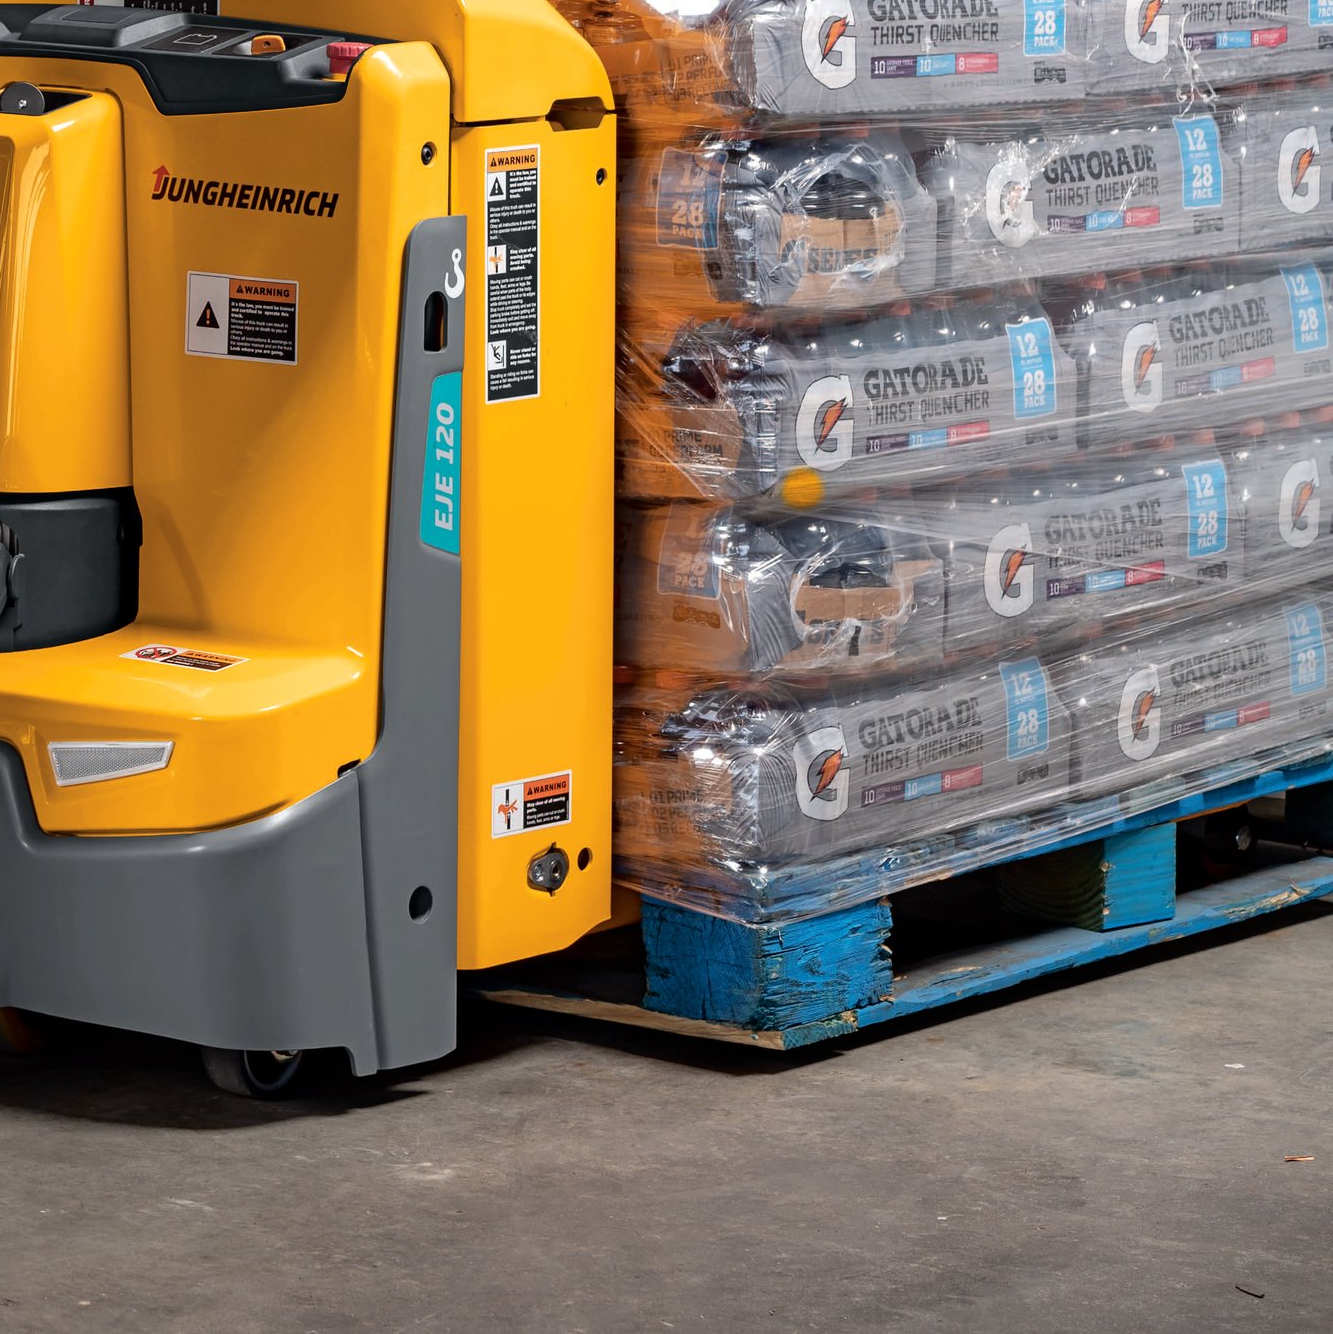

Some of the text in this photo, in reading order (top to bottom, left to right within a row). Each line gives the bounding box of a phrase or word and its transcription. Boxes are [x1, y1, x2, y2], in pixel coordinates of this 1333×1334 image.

[1034, 10, 1056, 35] 28
[1182, 1, 1222, 23] THIRST
[870, 23, 999, 47] THIRST QUENCHER
[1034, 36, 1056, 47] PACK
[874, 61, 885, 74] 10
[920, 59, 931, 72] 10
[959, 57, 964, 70] 8
[1185, 129, 1206, 151] 12
[497, 155, 535, 166] WARNING
[1043, 144, 1157, 185] GATORADE
[1278, 126, 1321, 214] G
[1191, 163, 1213, 187] 28
[151, 176, 339, 218] JUNGHEINRICH
[1045, 176, 1160, 208] THIRST QUENCHER
[1192, 188, 1213, 199] PACK
[671, 200, 704, 227] 28
[245, 286, 289, 297] WARNING
[1290, 274, 1309, 296] 12
[1169, 297, 1270, 344] GATORADE
[1299, 307, 1319, 332] 28
[1016, 333, 1039, 358] 12
[1301, 331, 1319, 343] PACK
[1121, 320, 1162, 413] G
[1174, 342, 1213, 367] THIRST
[863, 357, 988, 400] GATORADE
[1023, 370, 1046, 396] 28
[867, 390, 989, 426] THIRST QUENCHER
[1024, 395, 1045, 408] PACK
[795, 374, 855, 471] G
[869, 439, 880, 452] 10
[911, 434, 922, 447] 10
[950, 430, 957, 442] 8
[435, 402, 455, 531] EJE 120
[1193, 474, 1214, 499] 12
[1279, 458, 1321, 549] G
[1044, 499, 1162, 545] GATORADE
[1197, 510, 1218, 536] 28
[1198, 536, 1218, 549] PACK
[674, 575, 706, 588] PACK
[984, 523, 1034, 618] G
[1291, 616, 1310, 636] 12
[1297, 649, 1316, 672] 28
[1011, 673, 1032, 697] 12
[858, 696, 982, 750] GATORADE
[1017, 708, 1039, 735] 28
[1118, 664, 1162, 761] G
[1018, 735, 1038, 749] PACK
[793, 723, 851, 821] G
[861, 748, 910, 775] THIRST
[533, 781, 566, 794] WARNING
[907, 782, 918, 795] 10
[944, 775, 951, 788] 8
[864, 789, 875, 804] 10
